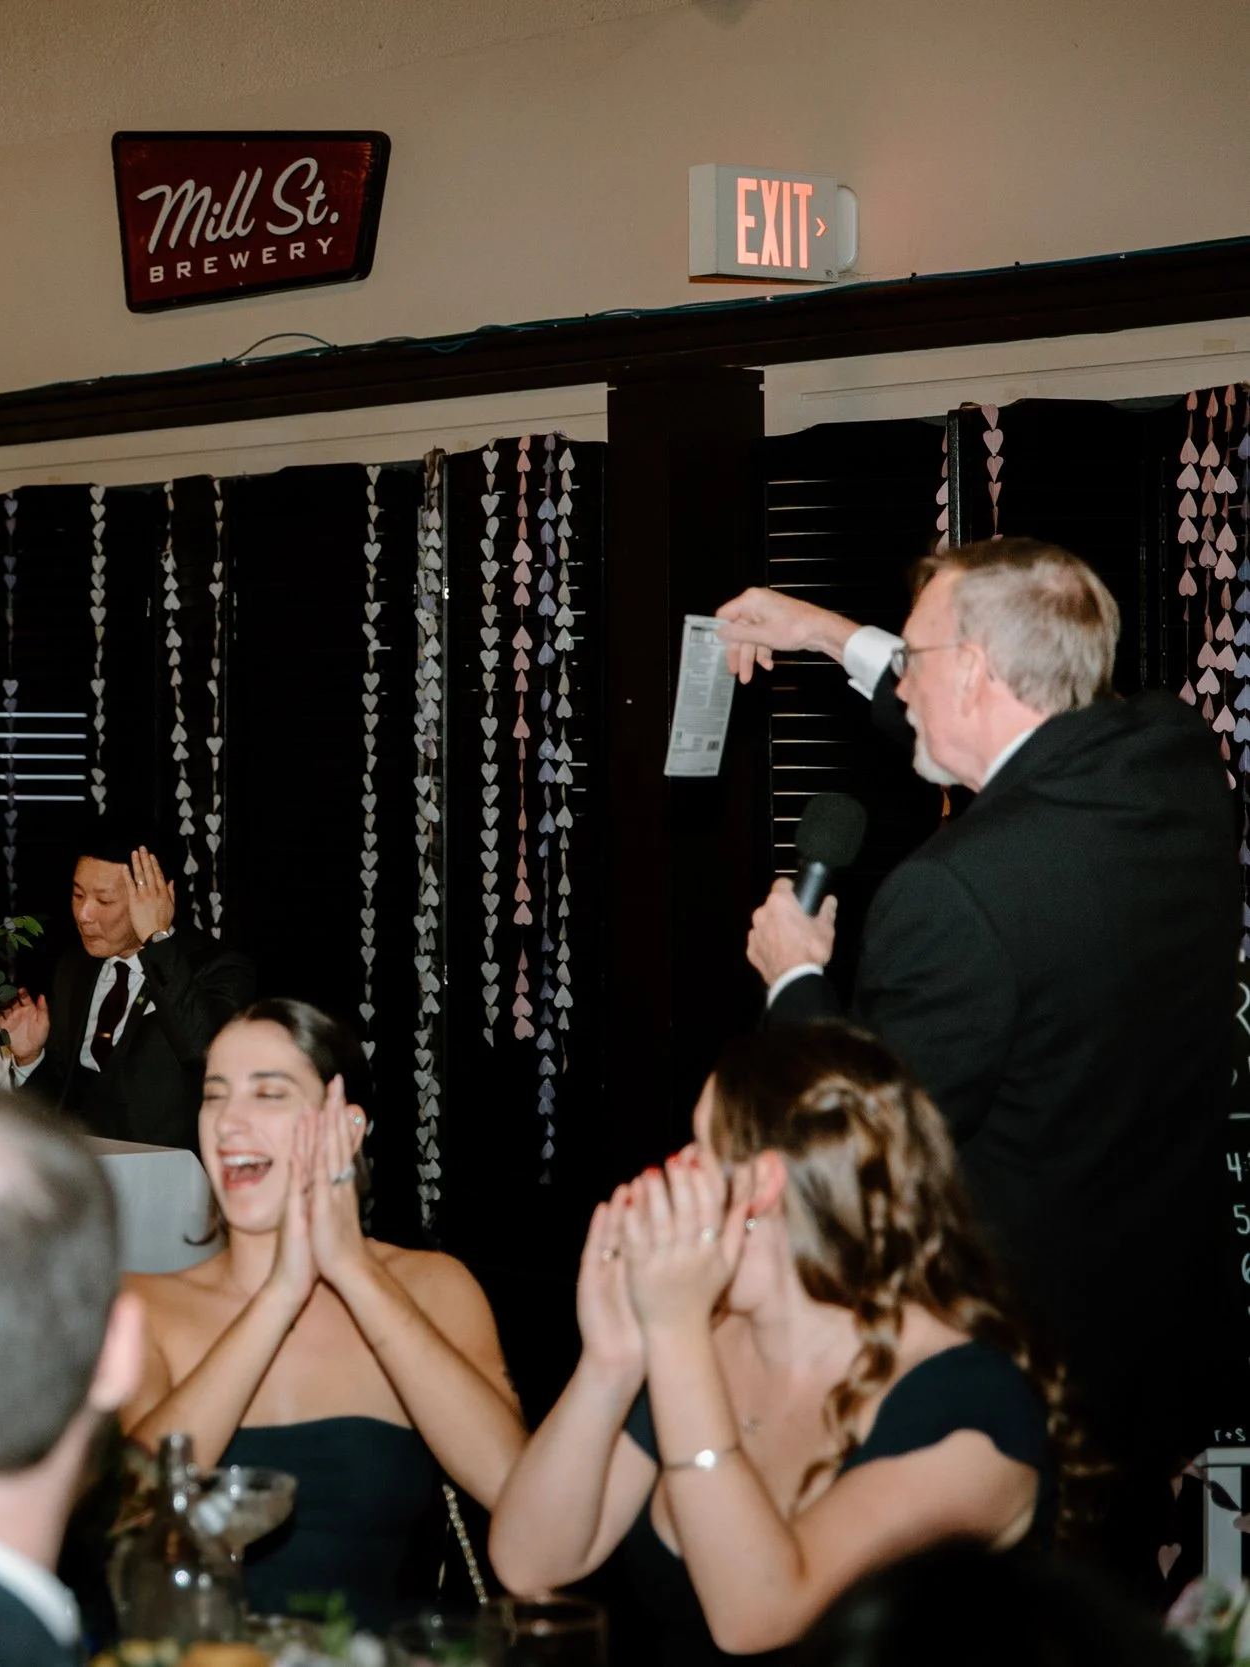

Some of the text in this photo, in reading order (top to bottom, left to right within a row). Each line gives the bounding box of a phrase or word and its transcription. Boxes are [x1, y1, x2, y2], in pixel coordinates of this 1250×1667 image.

[137, 157, 339, 254] Mill St.
[737, 177, 813, 269] EXIT
[149, 236, 333, 283] BREWERY
